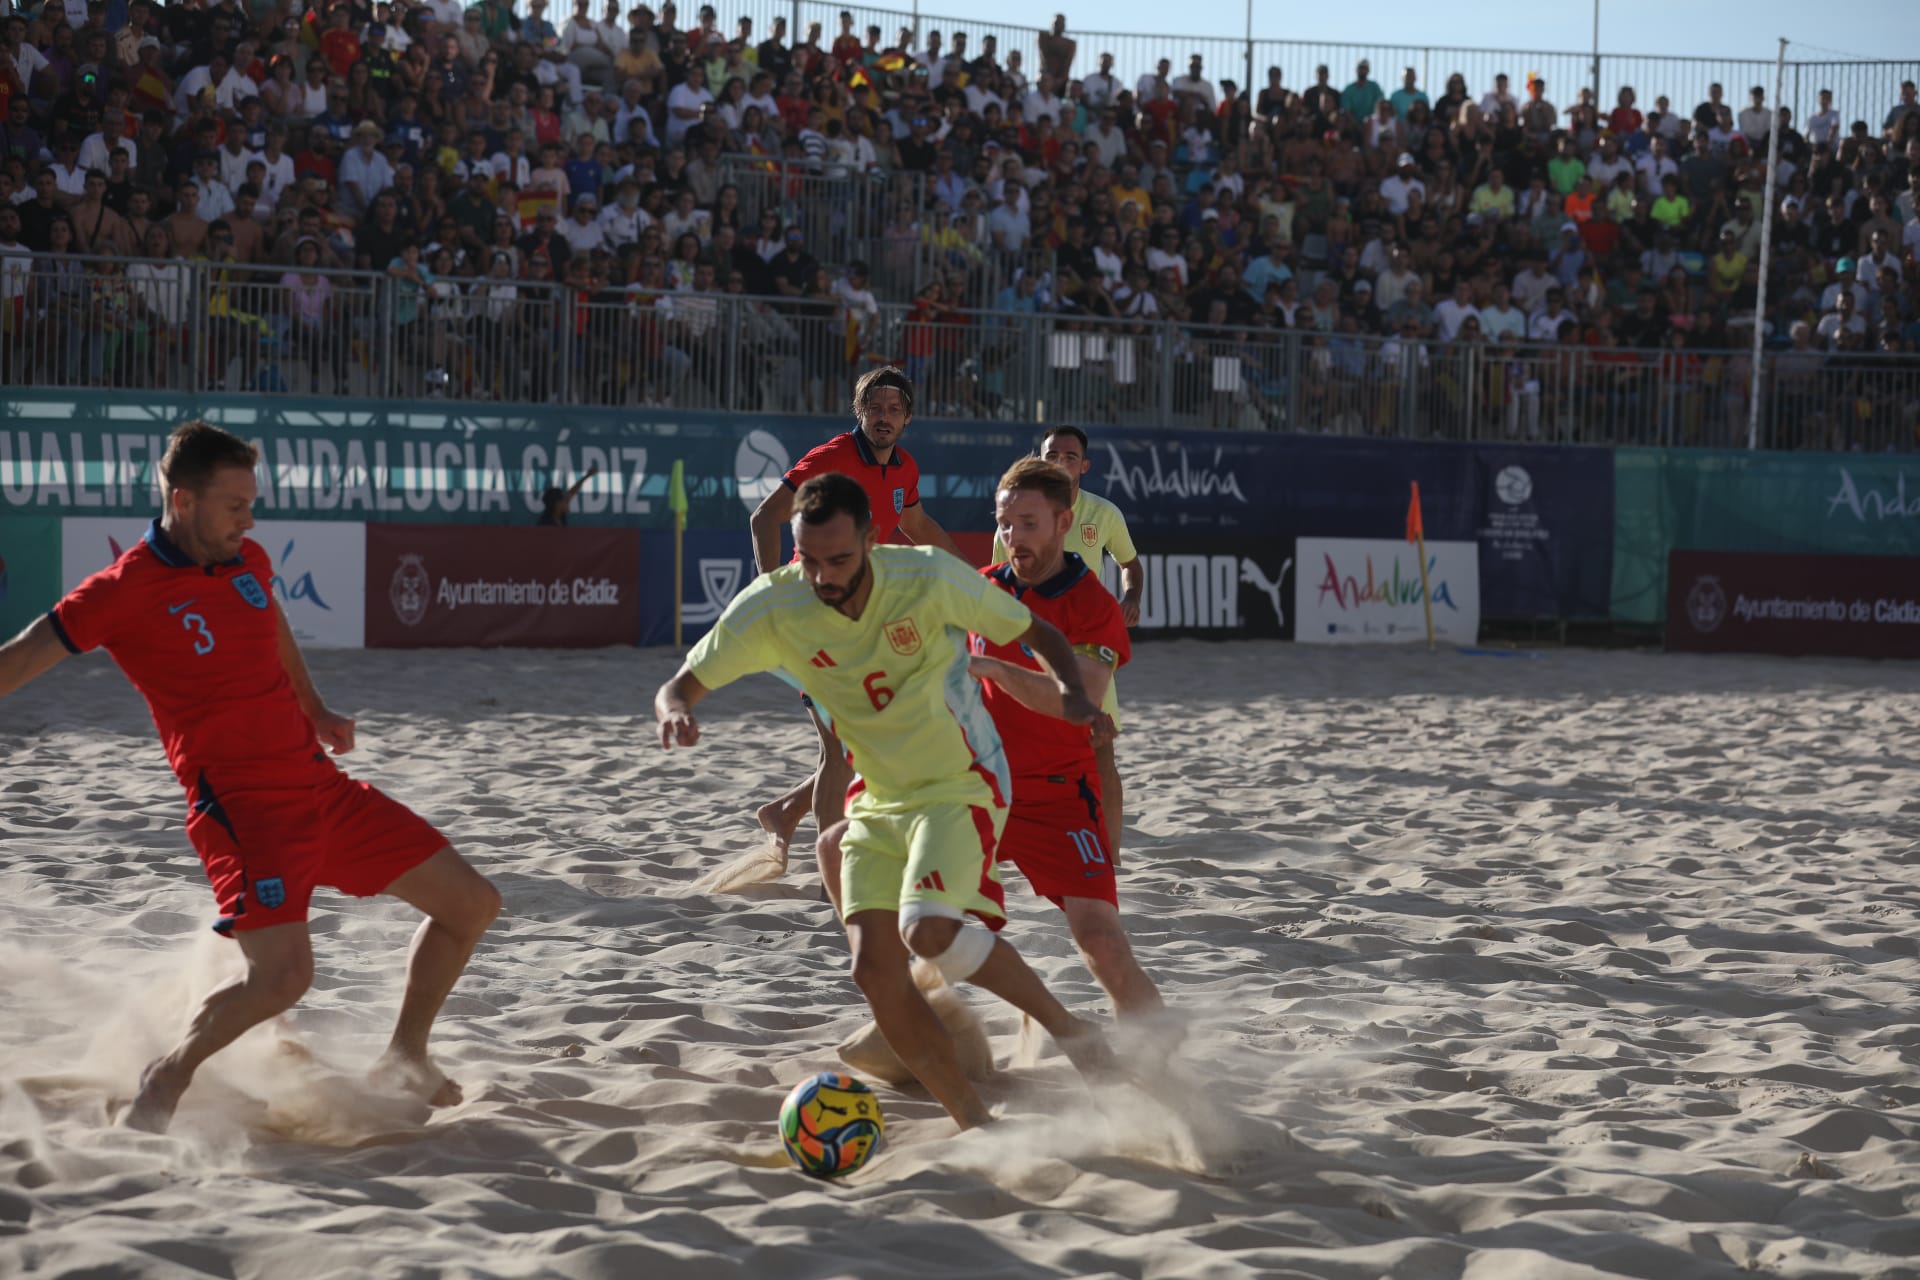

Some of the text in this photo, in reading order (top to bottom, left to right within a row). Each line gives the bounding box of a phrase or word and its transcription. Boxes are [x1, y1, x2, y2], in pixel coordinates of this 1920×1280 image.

[0, 418, 651, 514] UALIFI ANDALUCÍA CÁDIZ
[1102, 441, 1248, 502] Andalucía
[437, 577, 619, 610] Ayuntamiento de Cádiz
[1733, 593, 1846, 622] Ayuntamiento
[1849, 598, 1871, 622] de
[182, 612, 215, 656] 3
[863, 671, 895, 712] 6
[1066, 828, 1105, 865] 10
